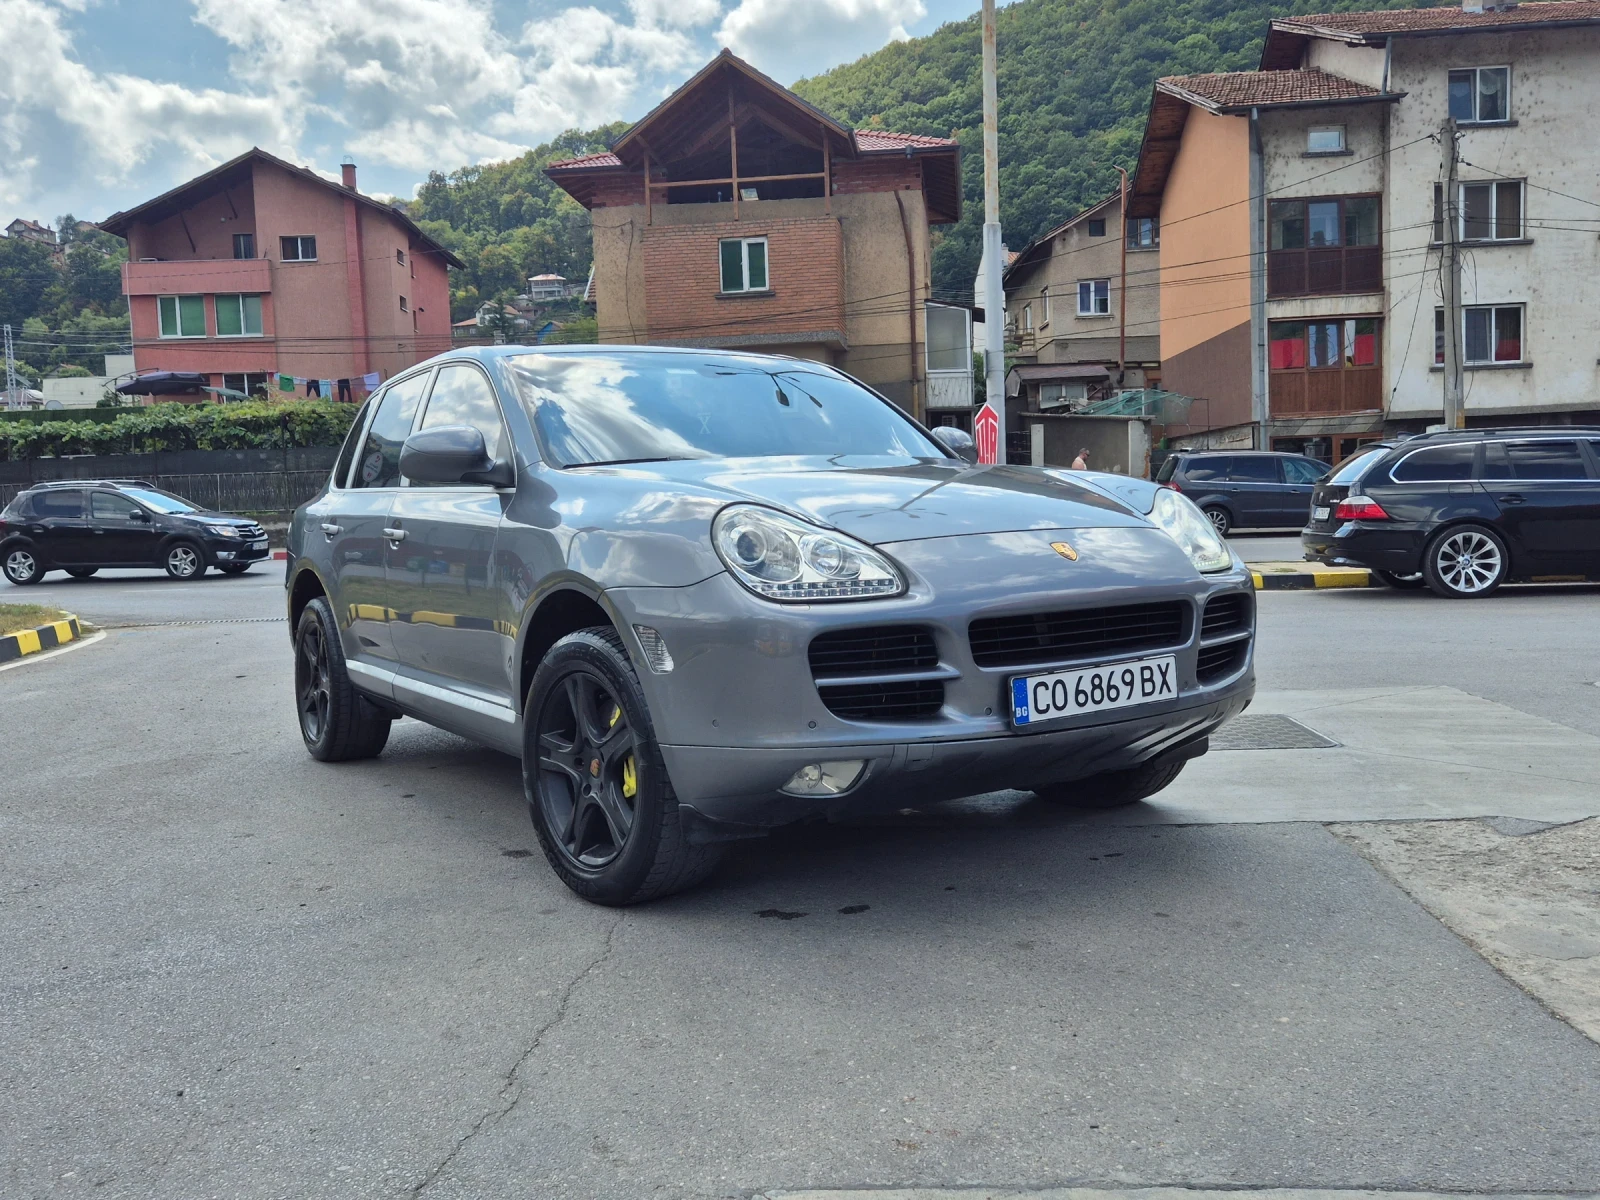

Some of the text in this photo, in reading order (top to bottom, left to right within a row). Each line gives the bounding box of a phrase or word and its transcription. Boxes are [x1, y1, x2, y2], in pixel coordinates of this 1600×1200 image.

[1033, 662, 1172, 714] CO 6869 BX
[1015, 707, 1028, 718] BG
